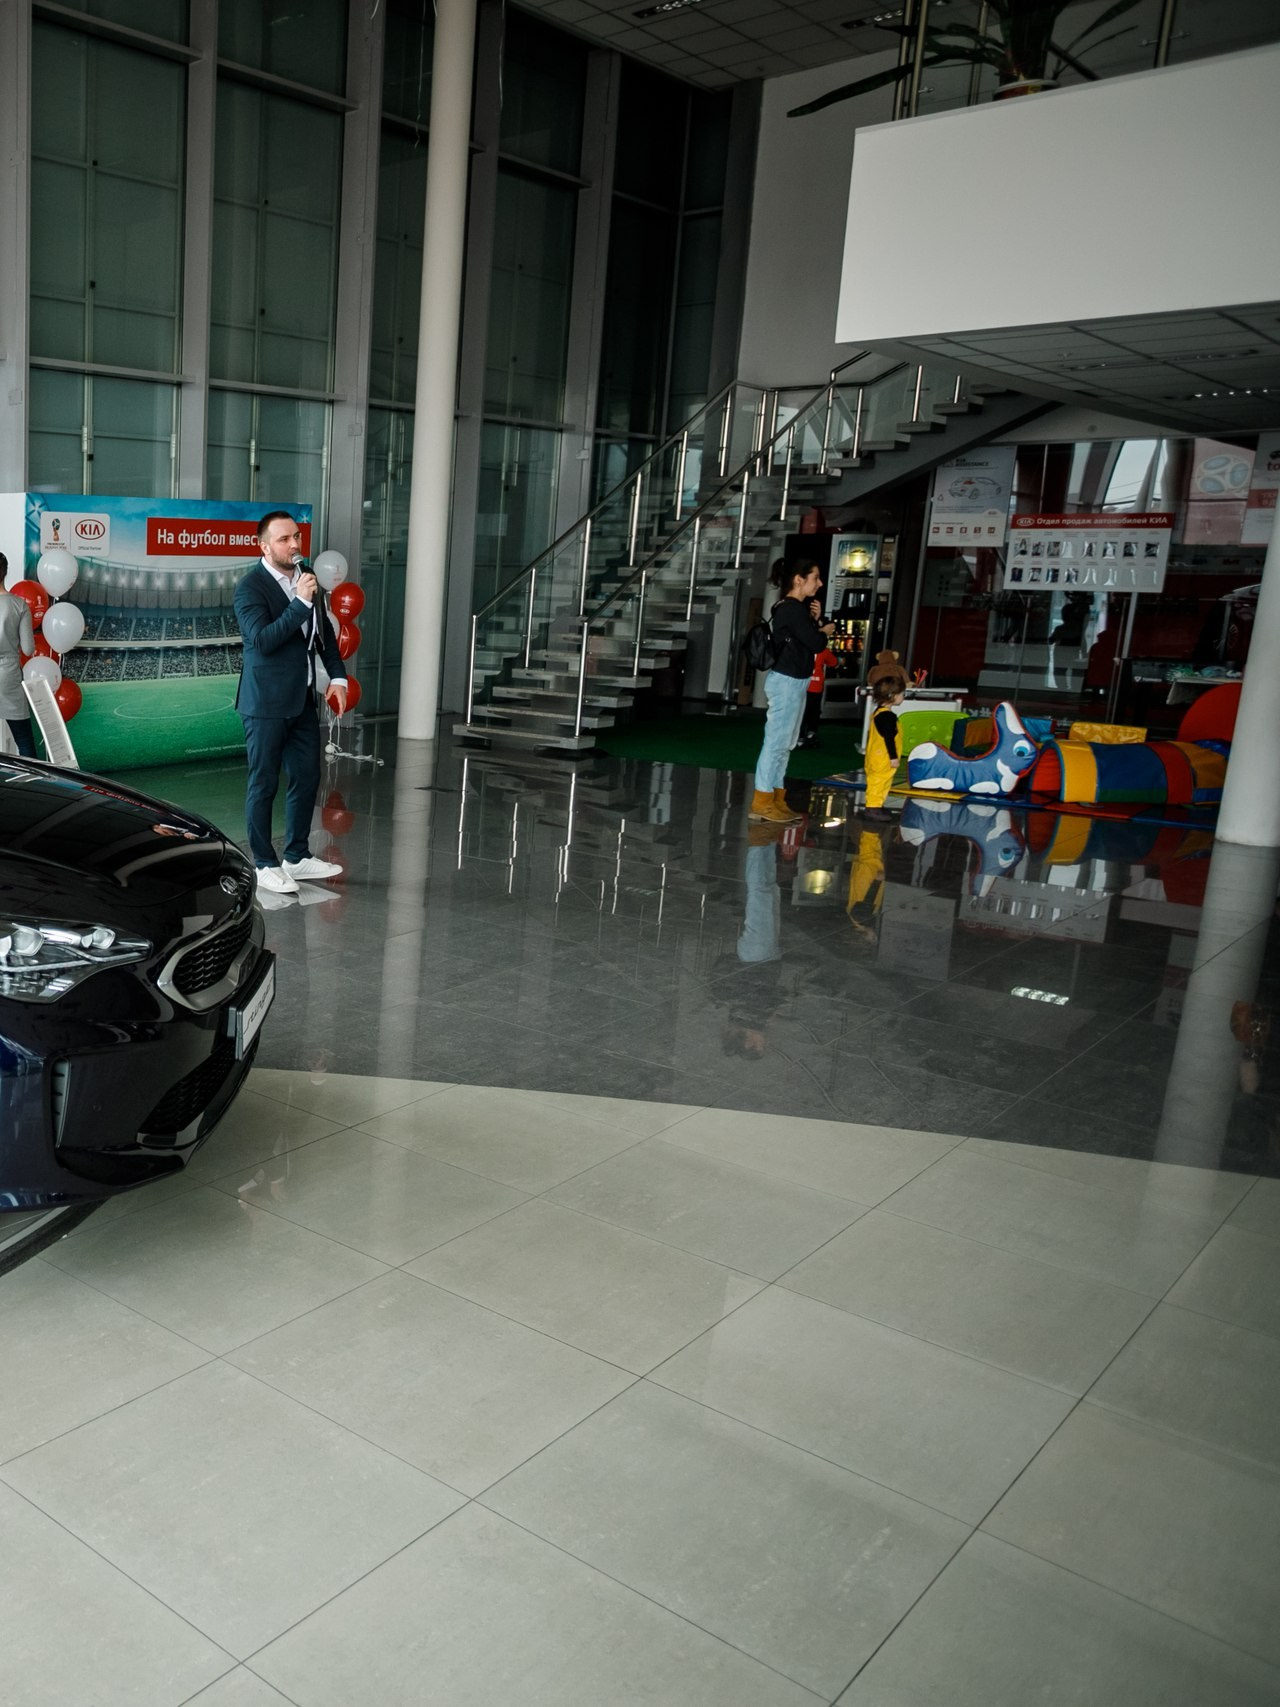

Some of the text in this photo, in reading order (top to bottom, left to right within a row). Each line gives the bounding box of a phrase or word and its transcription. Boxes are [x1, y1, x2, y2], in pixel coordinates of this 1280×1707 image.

[1036, 518, 1060, 526] Отдел
[1062, 518, 1092, 526] продаж
[1094, 517, 1147, 525] автомобилей
[157, 528, 174, 544] На
[178, 528, 225, 548] футбол
